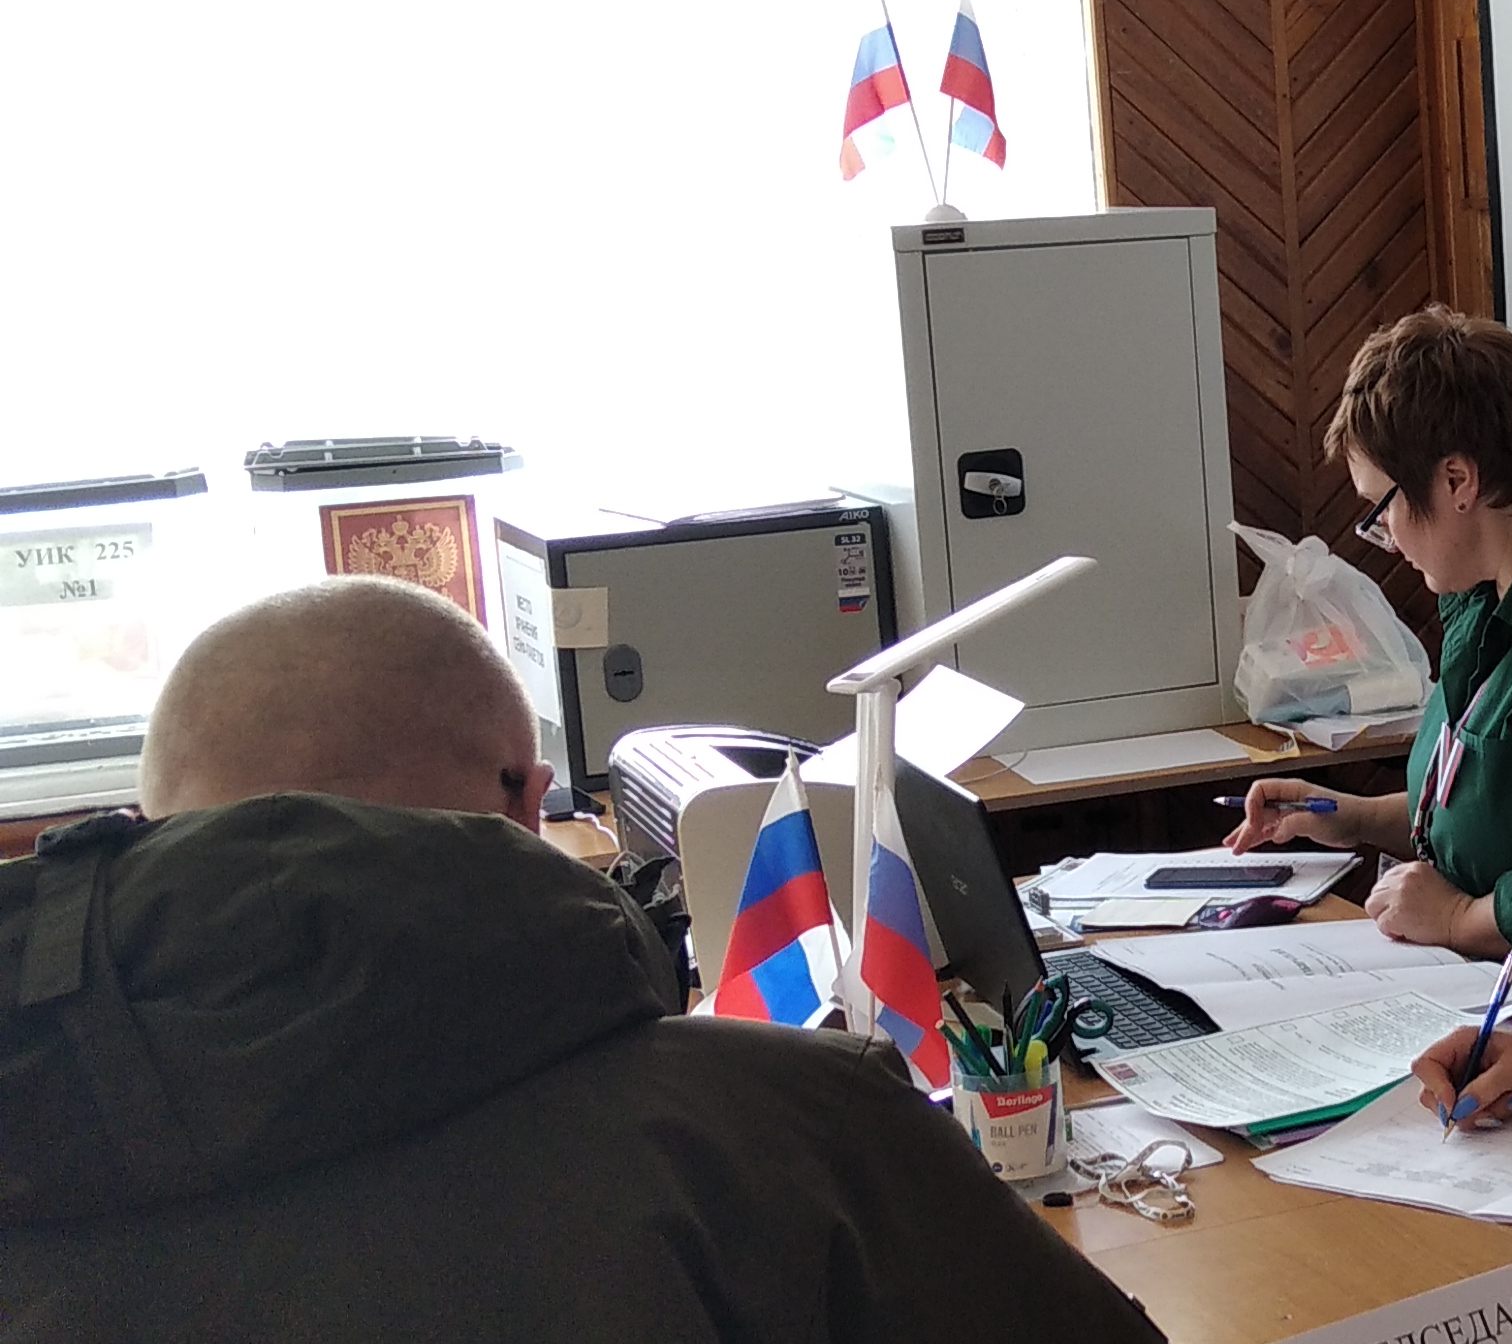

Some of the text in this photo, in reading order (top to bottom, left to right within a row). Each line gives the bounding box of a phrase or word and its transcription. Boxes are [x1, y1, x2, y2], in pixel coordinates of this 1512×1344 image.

[840, 510, 870, 521] AIKO
[15, 540, 134, 568] УИК 225
[59, 578, 97, 600] №1
[990, 1123, 1037, 1138] BALL PEN
